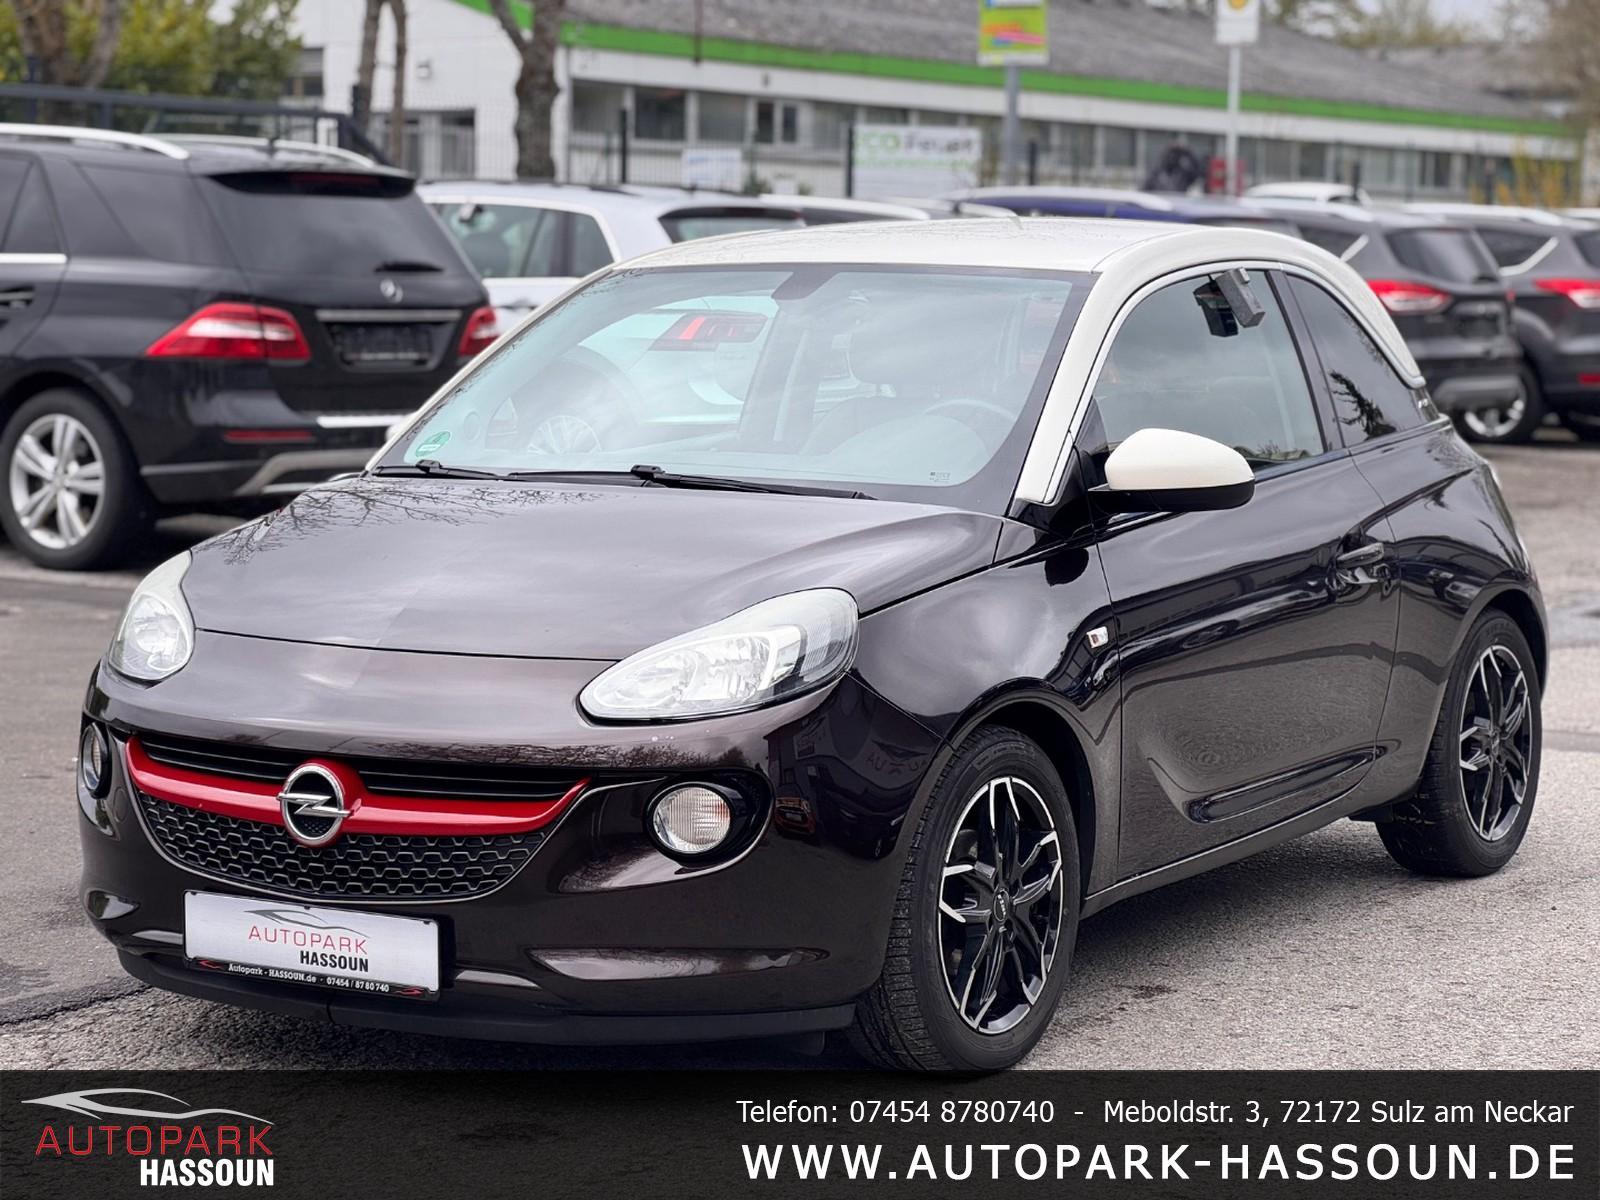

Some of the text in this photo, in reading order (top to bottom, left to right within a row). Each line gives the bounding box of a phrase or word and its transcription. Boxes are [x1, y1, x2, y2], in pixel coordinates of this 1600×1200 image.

[248, 924, 368, 955] AUTOPARK
[299, 949, 369, 973] HASSOUN
[228, 963, 263, 976] Autopark
[268, 969, 317, 983] HASSOUN.de
[326, 976, 350, 988] 07454
